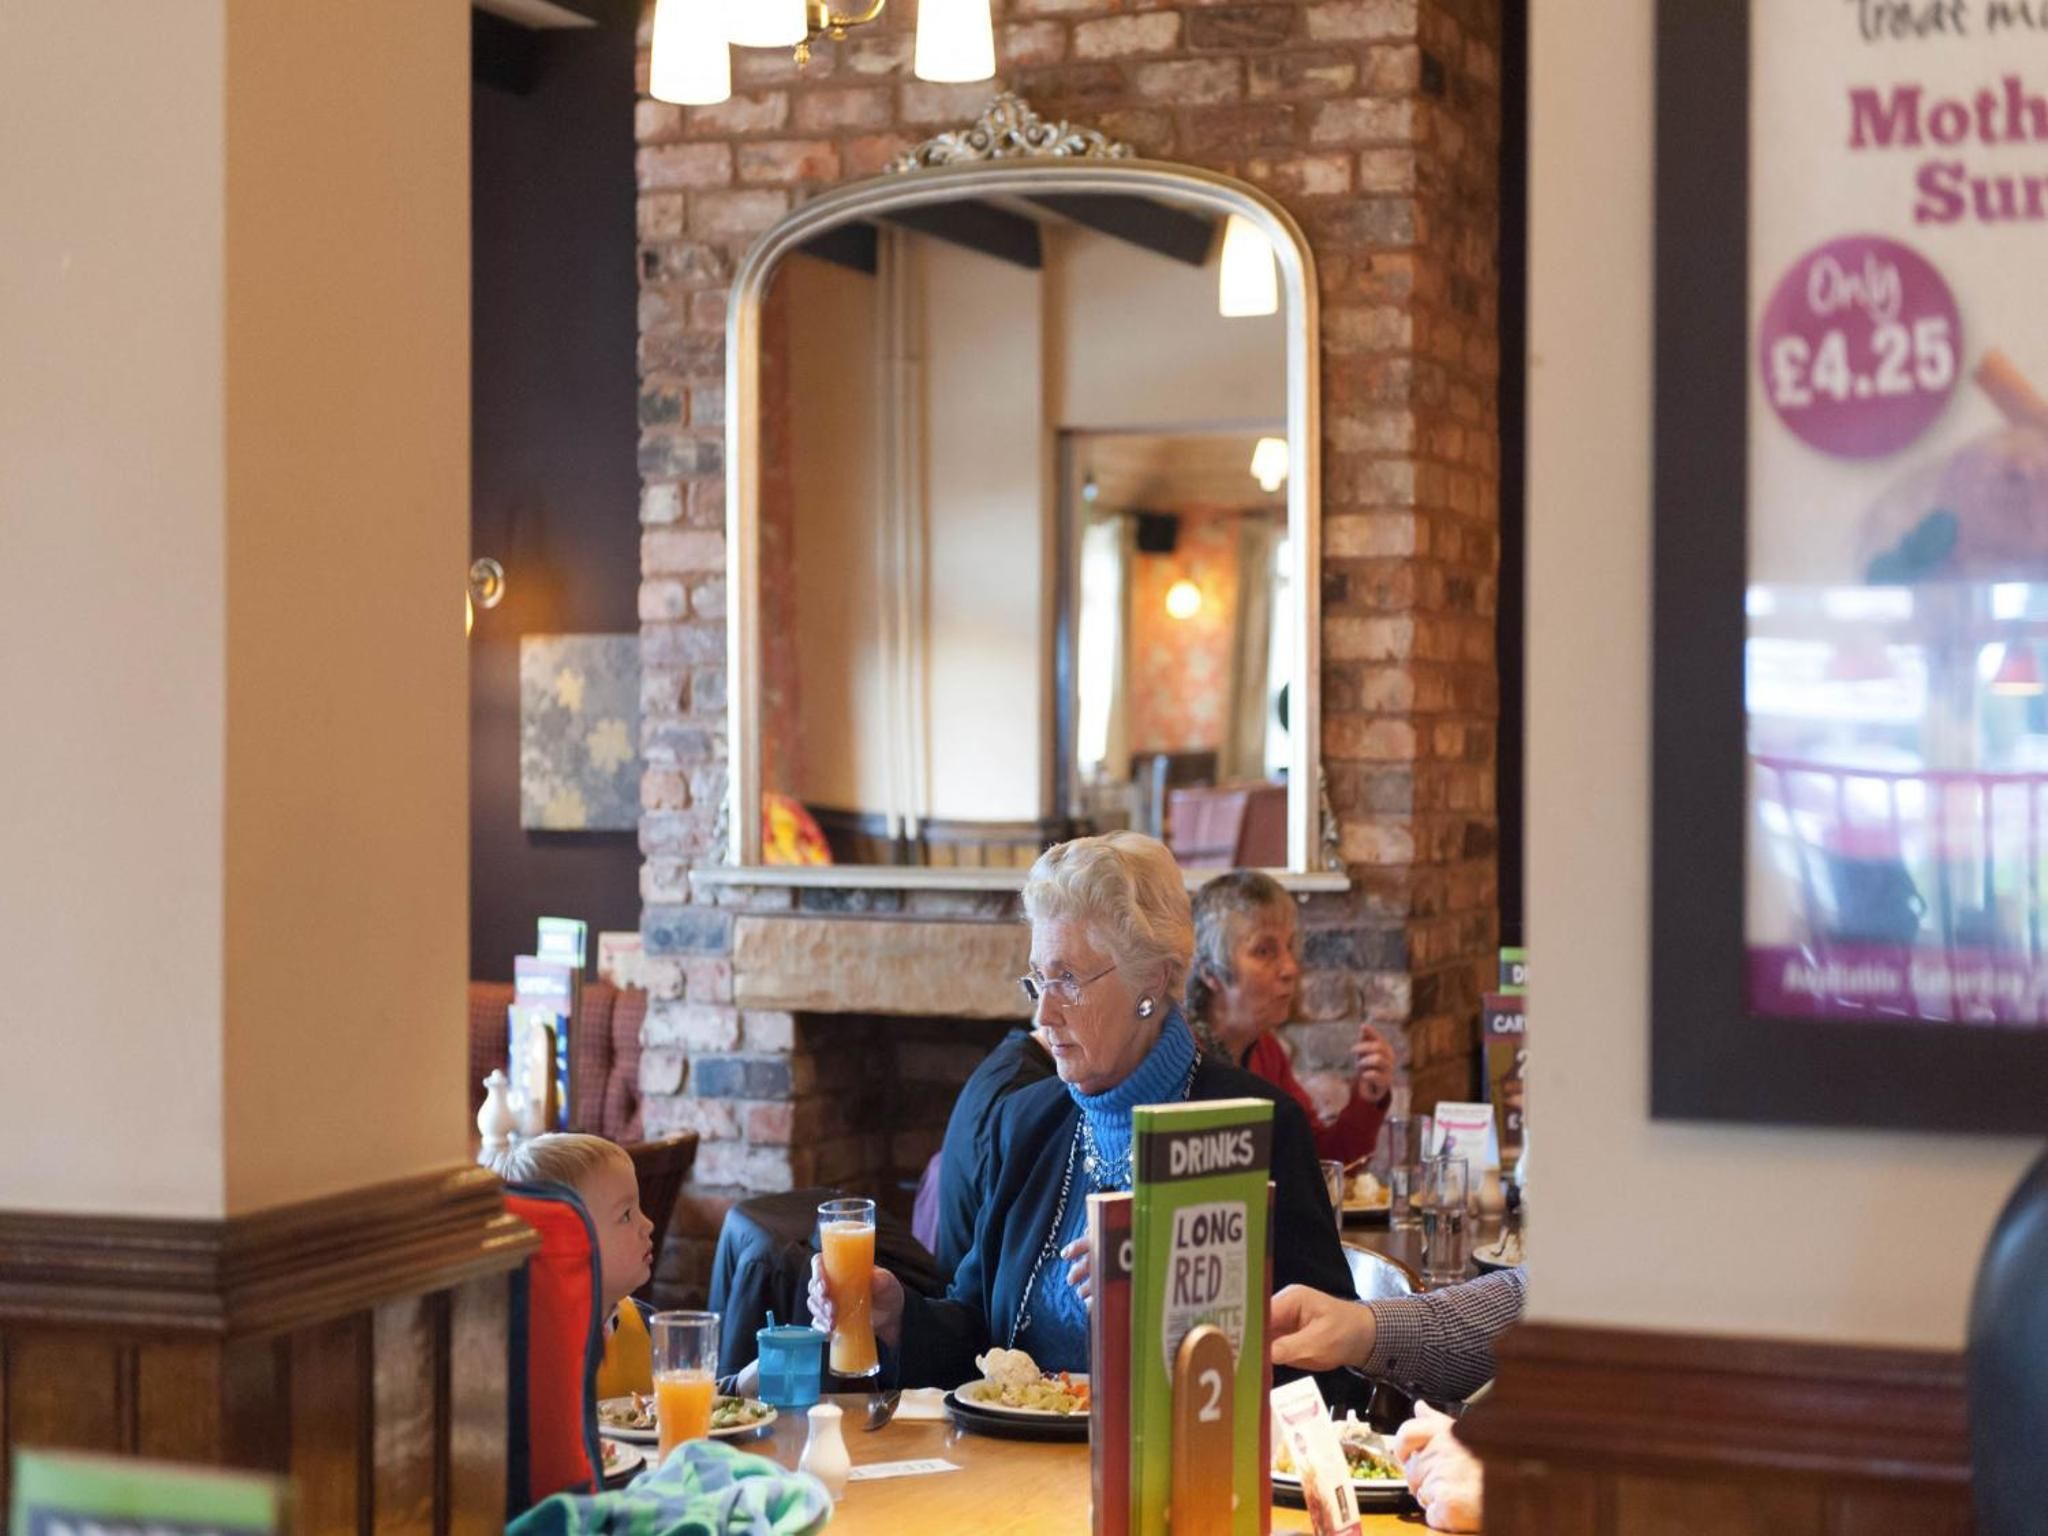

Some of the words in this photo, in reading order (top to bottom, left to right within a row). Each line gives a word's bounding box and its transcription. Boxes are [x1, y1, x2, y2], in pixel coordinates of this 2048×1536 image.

[1808, 252, 1902, 322] Only
[1772, 317, 1954, 407] £4.25
[1170, 1129, 1254, 1176] DRINKS
[1177, 1211, 1242, 1249] LONG
[1173, 1254, 1222, 1307] RED
[1199, 1369, 1222, 1421] 2
